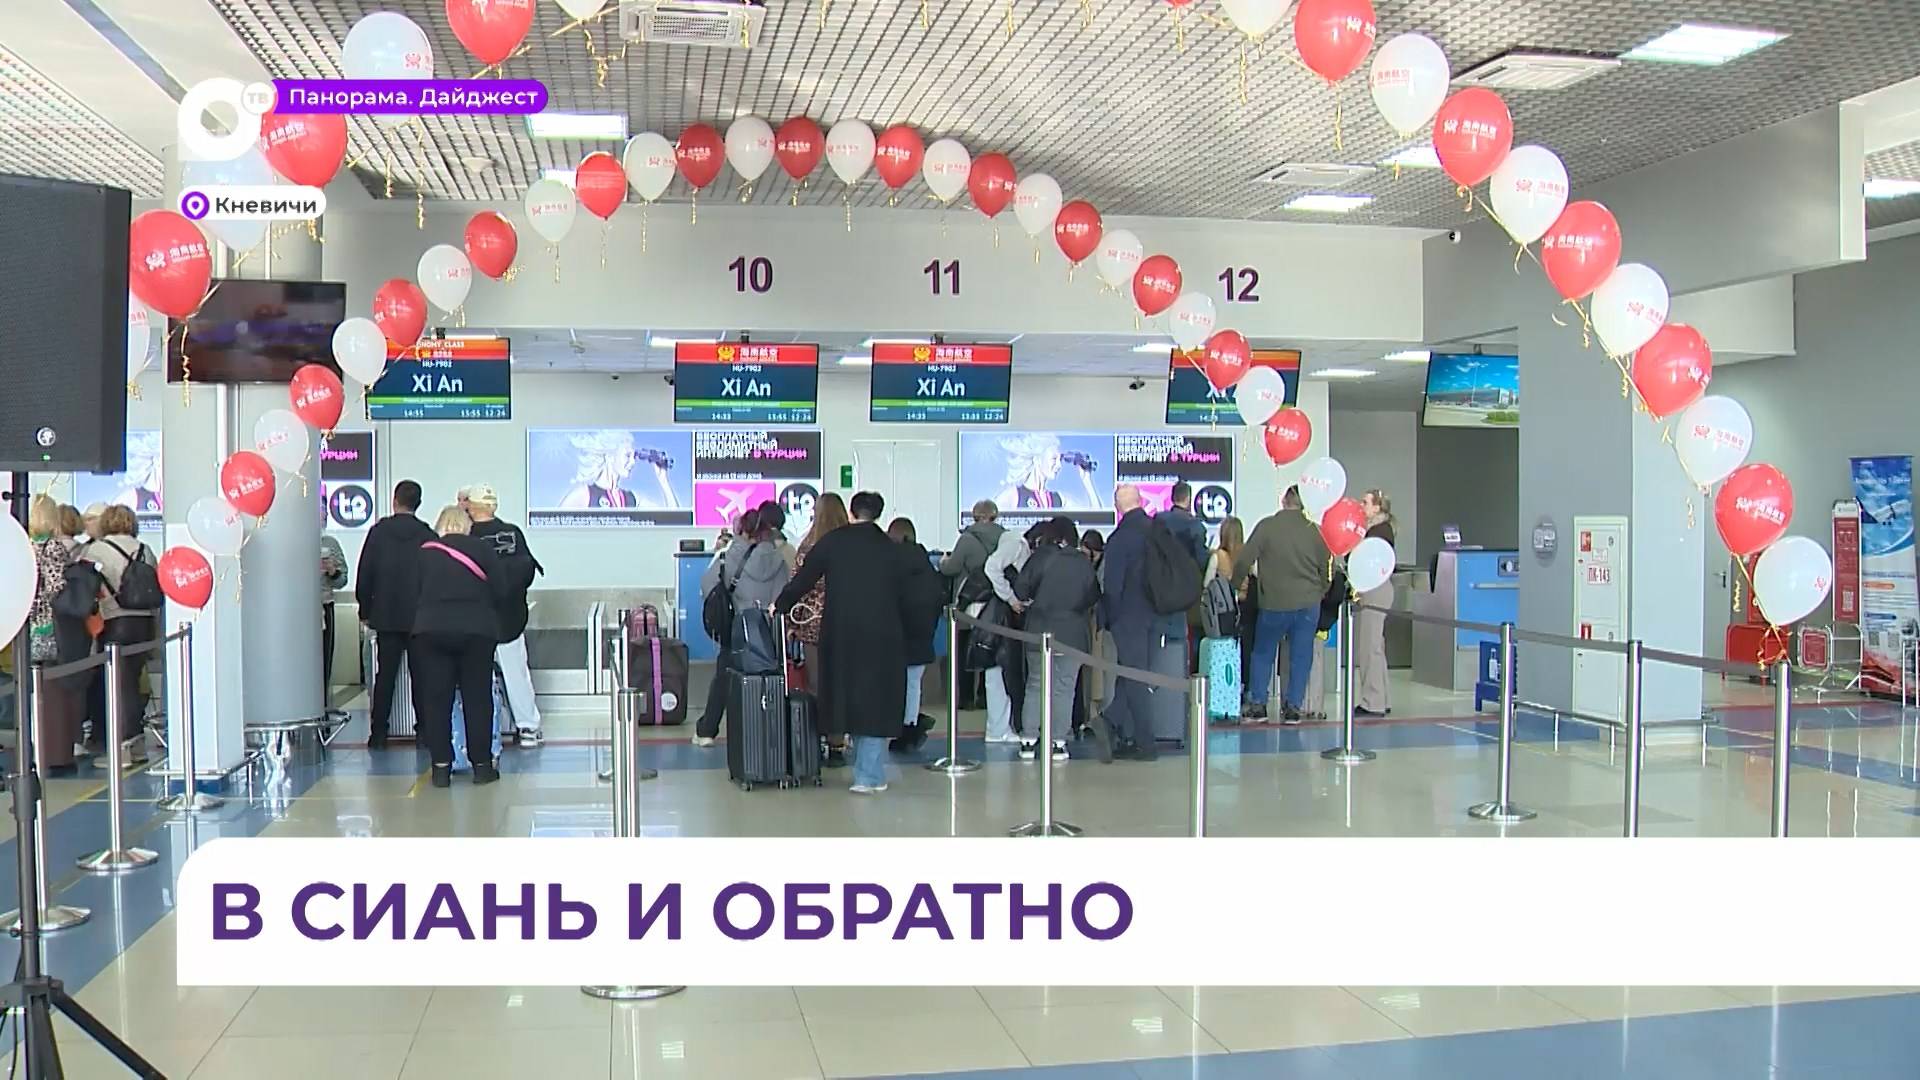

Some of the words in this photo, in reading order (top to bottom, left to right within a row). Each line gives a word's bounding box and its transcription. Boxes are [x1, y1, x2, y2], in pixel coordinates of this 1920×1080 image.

[728, 256, 773, 293] 10
[923, 259, 960, 295] 11
[1218, 267, 1259, 302] 12
[412, 374, 432, 392] Xi
[437, 374, 463, 392] An
[721, 377, 742, 397] Xi
[745, 378, 771, 397] An
[917, 377, 937, 396] Xi
[940, 378, 965, 397] An
[764, 449, 808, 459] ТУРЦИИ
[1181, 452, 1220, 463] ТУРЦИИ
